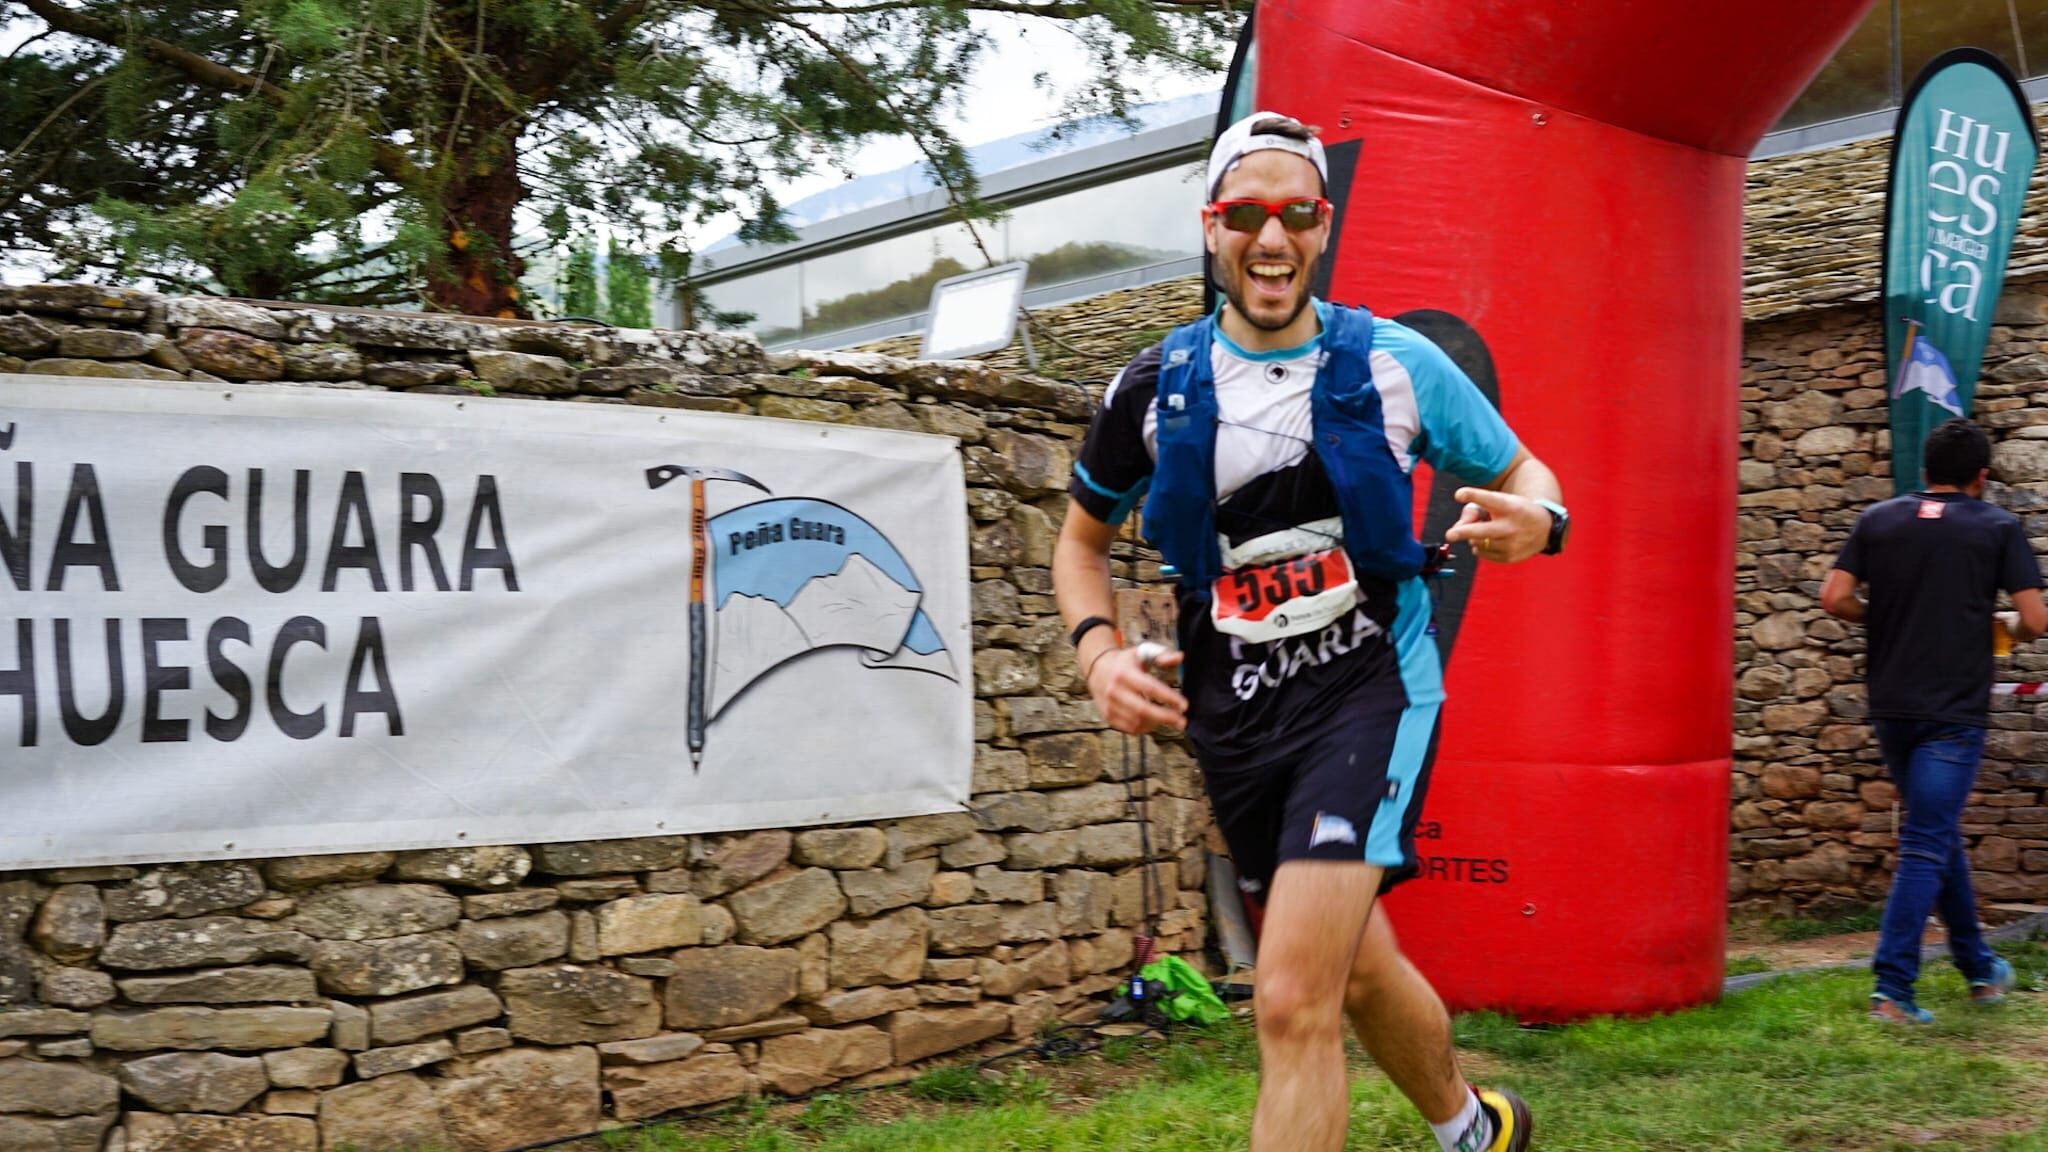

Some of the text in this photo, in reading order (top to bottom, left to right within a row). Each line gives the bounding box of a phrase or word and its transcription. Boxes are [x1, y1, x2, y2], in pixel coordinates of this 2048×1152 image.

[163, 464, 521, 594] GUARA
[729, 517, 846, 556] Peña Guara
[1231, 608, 1383, 700] GUARA
